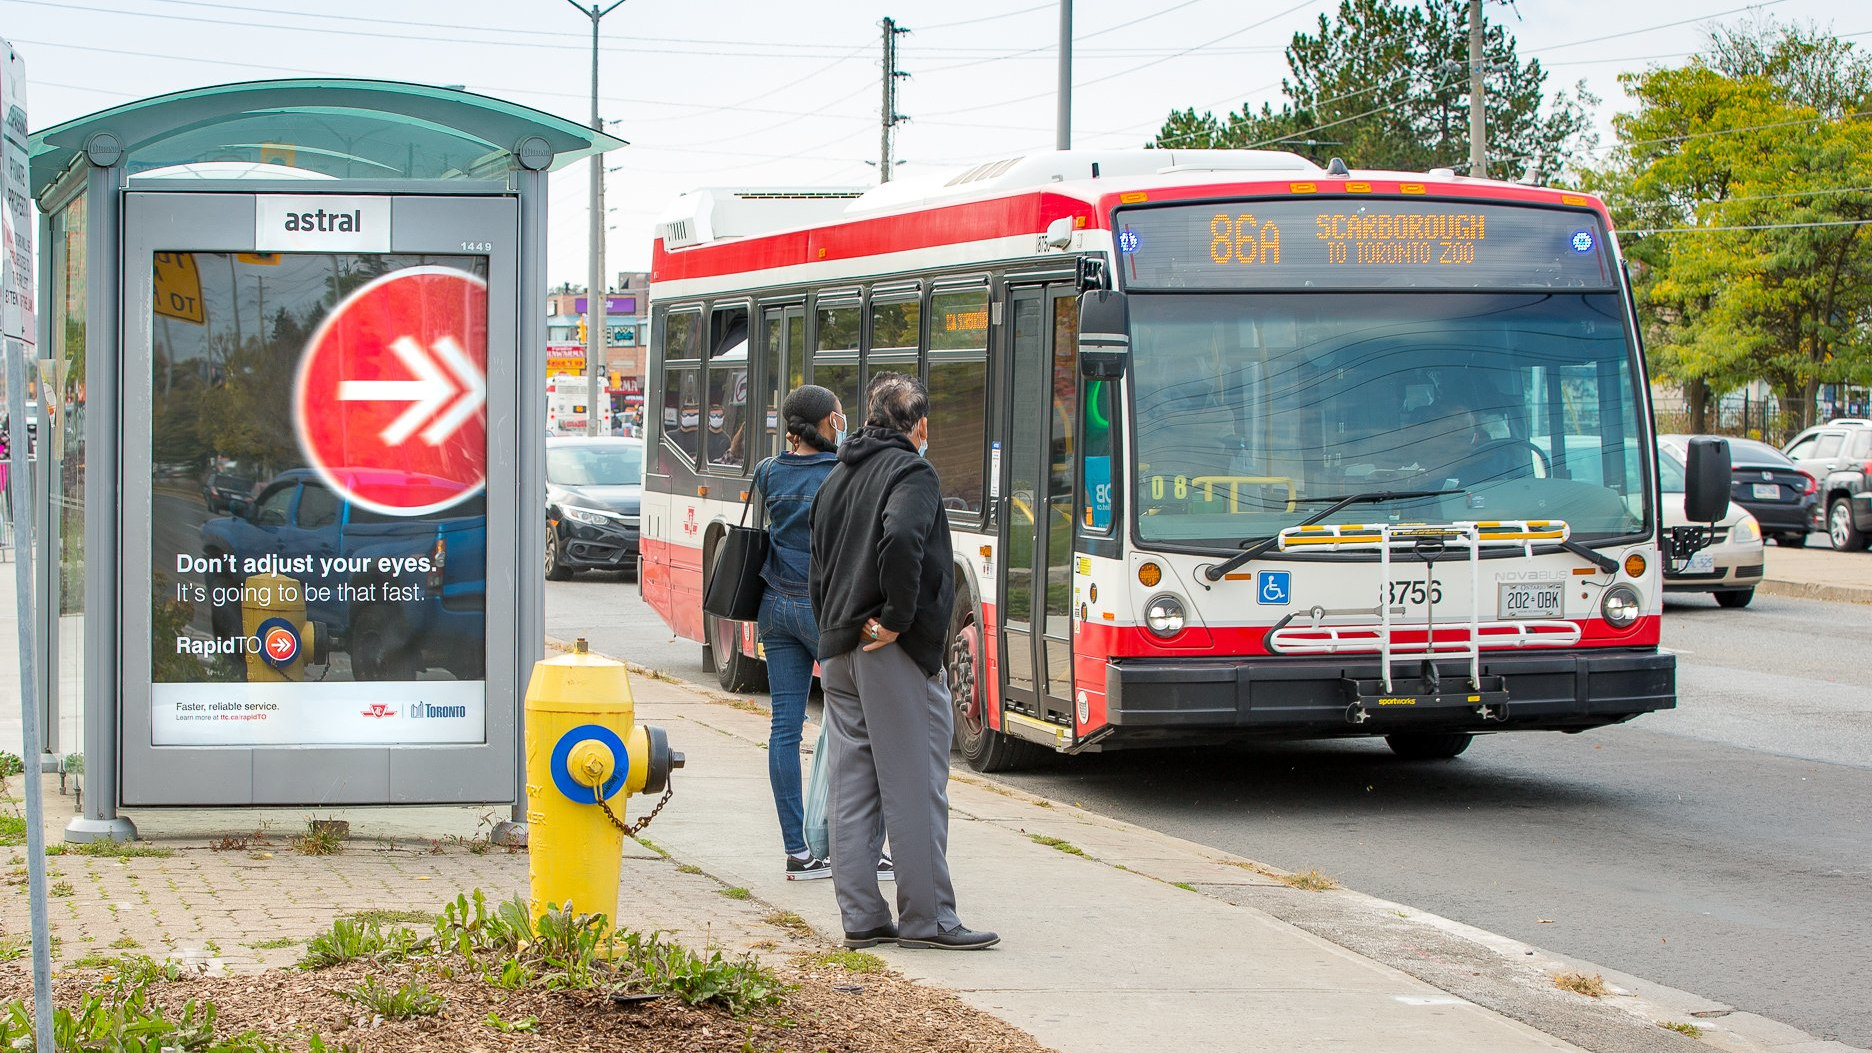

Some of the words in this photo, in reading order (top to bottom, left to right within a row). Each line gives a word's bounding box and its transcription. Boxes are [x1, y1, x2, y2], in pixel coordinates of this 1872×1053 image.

[285, 209, 361, 232] astral
[1316, 214, 1485, 239] SCARBOROUGH
[460, 241, 492, 251] 1449
[1210, 214, 1280, 264] 86A
[1327, 241, 1347, 264] TO
[1356, 241, 1431, 264] TORONTO
[1439, 241, 1475, 264] ZOO
[176, 554, 237, 574] Don't
[243, 554, 314, 578] adjust
[319, 556, 372, 578] your
[378, 556, 437, 578] eyes.
[177, 583, 206, 602] It's
[212, 583, 272, 607] going
[278, 584, 298, 602] to
[304, 583, 331, 602] be
[337, 583, 376, 602] that
[382, 582, 425, 602] fast.
[1379, 580, 1442, 605] 8756
[176, 636, 262, 658] RapidTO
[176, 702, 206, 712] Faster,
[208, 702, 242, 711] reliable
[244, 702, 280, 711] service.
[425, 703, 466, 718] TORONTO
[1379, 697, 1416, 706] sportworks
